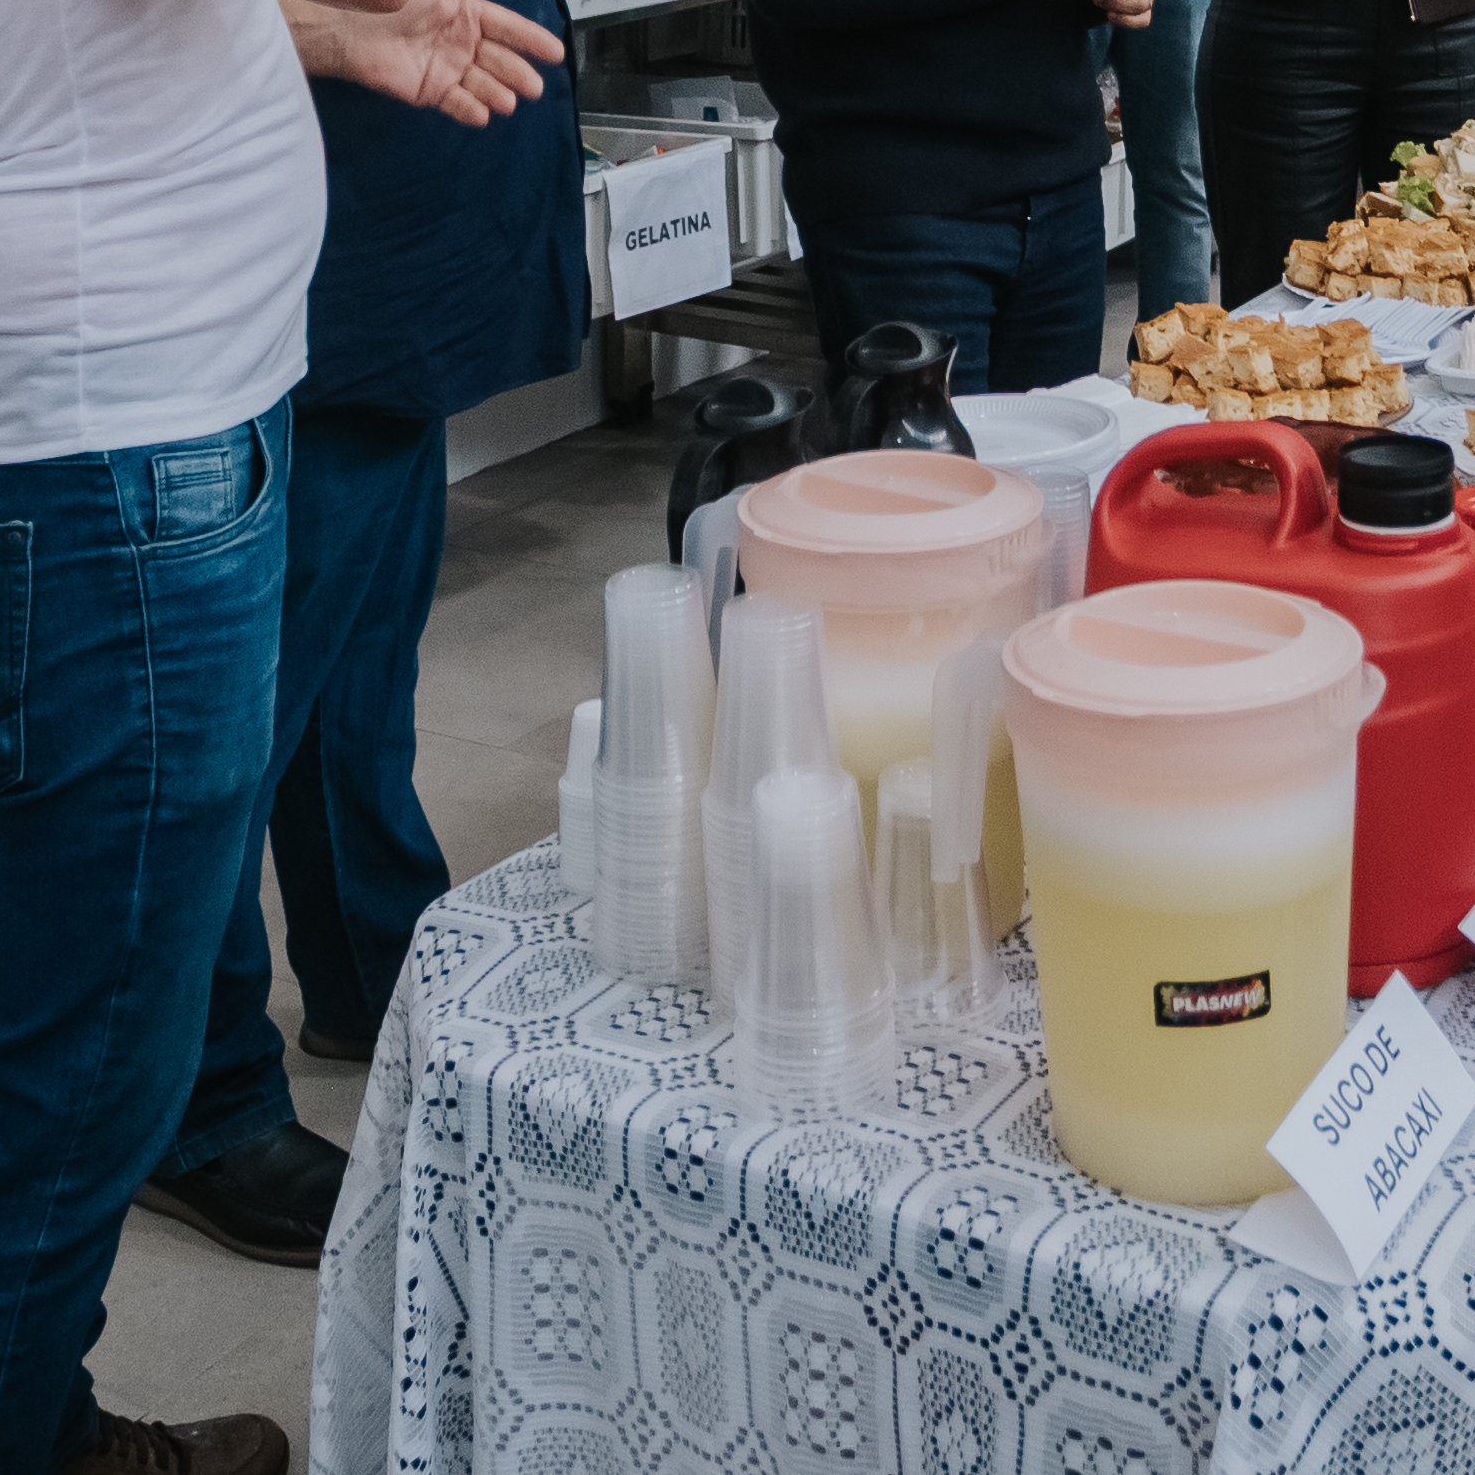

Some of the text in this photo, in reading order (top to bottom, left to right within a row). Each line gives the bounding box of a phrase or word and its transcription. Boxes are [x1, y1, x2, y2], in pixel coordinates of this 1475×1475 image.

[625, 211, 712, 251] GELATINA
[1172, 989, 1263, 1012] PLASNEW
[1312, 1024, 1401, 1146] SUCO DE
[1364, 1086, 1444, 1214] ABACAXI
